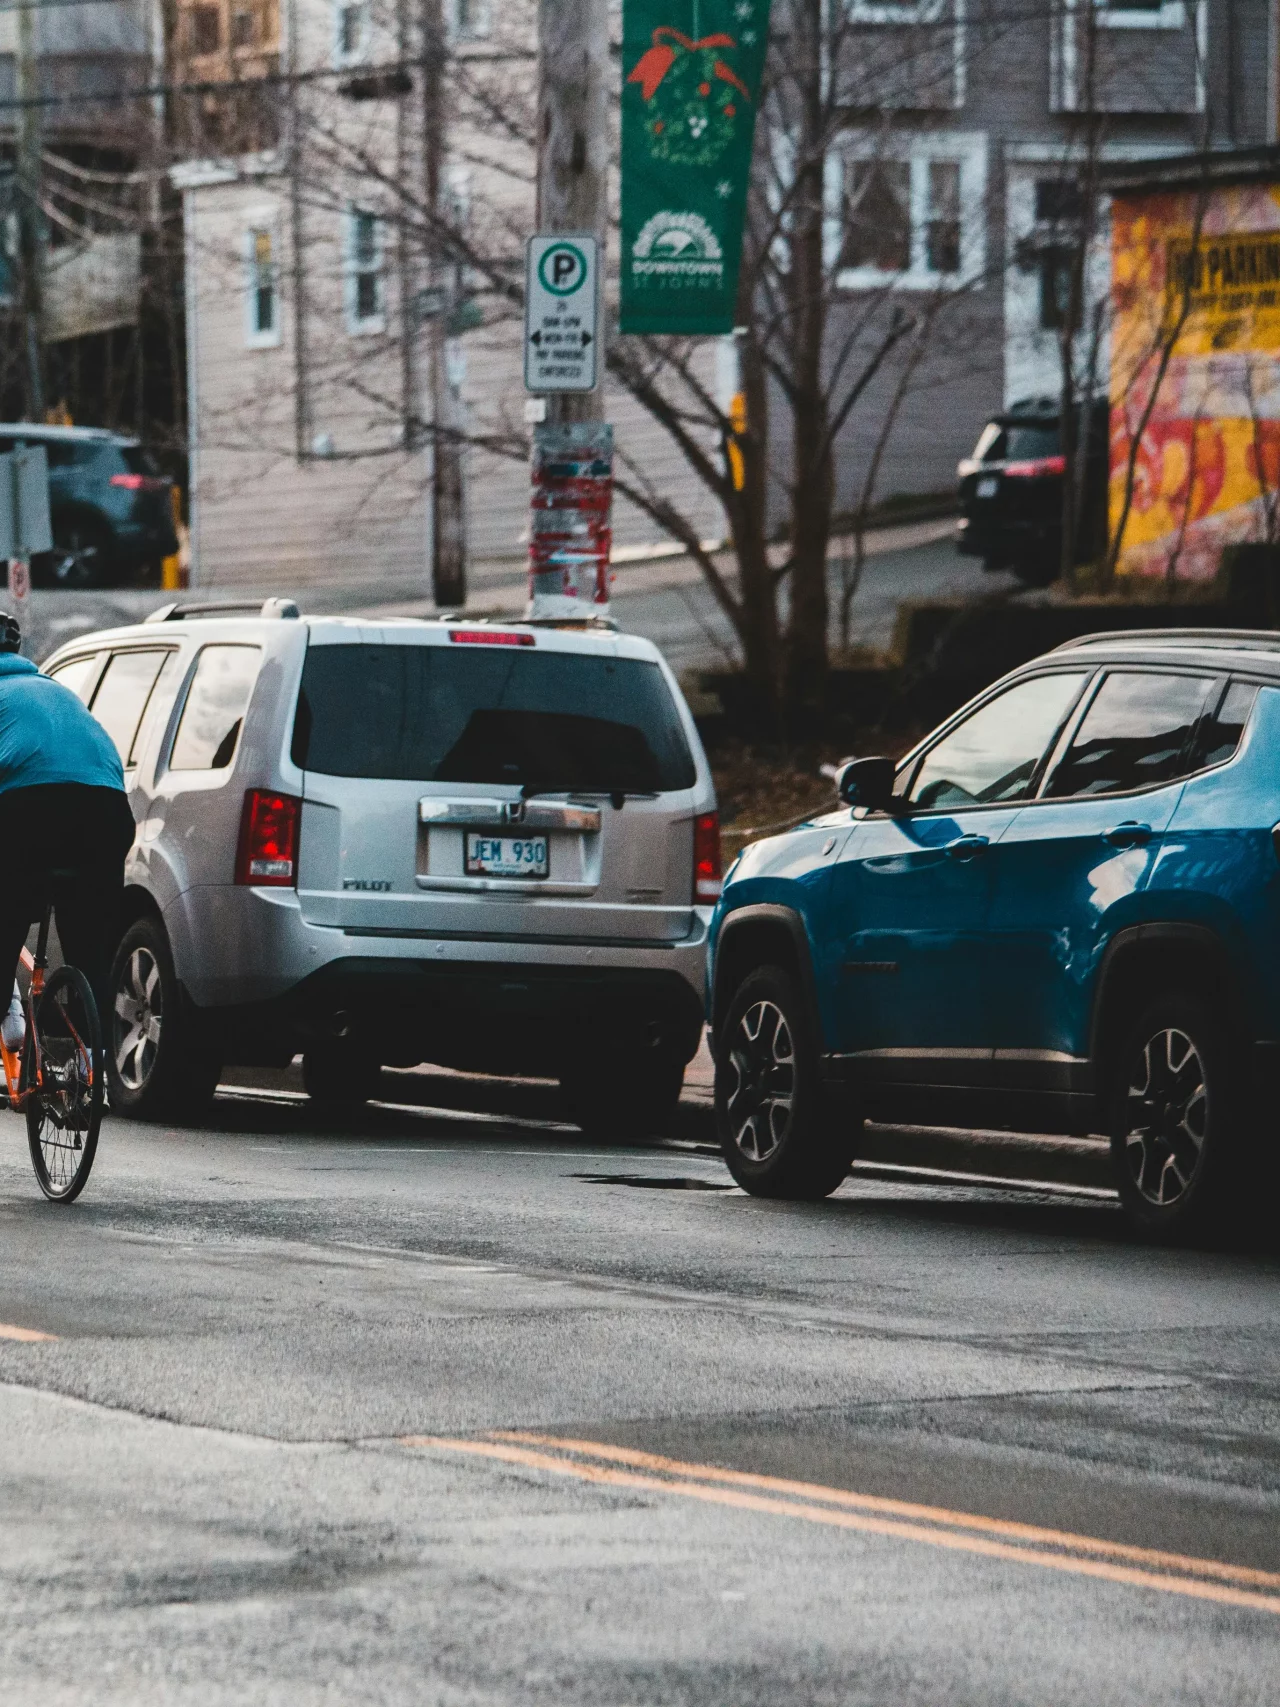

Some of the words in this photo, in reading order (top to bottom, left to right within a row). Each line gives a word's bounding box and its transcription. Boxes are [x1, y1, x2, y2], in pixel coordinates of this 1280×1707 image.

[553, 253, 576, 285] P
[632, 261, 723, 275] DOWNTOWN
[471, 840, 502, 861] JEM
[513, 842, 546, 863] 930
[343, 878, 394, 891] PILOT
